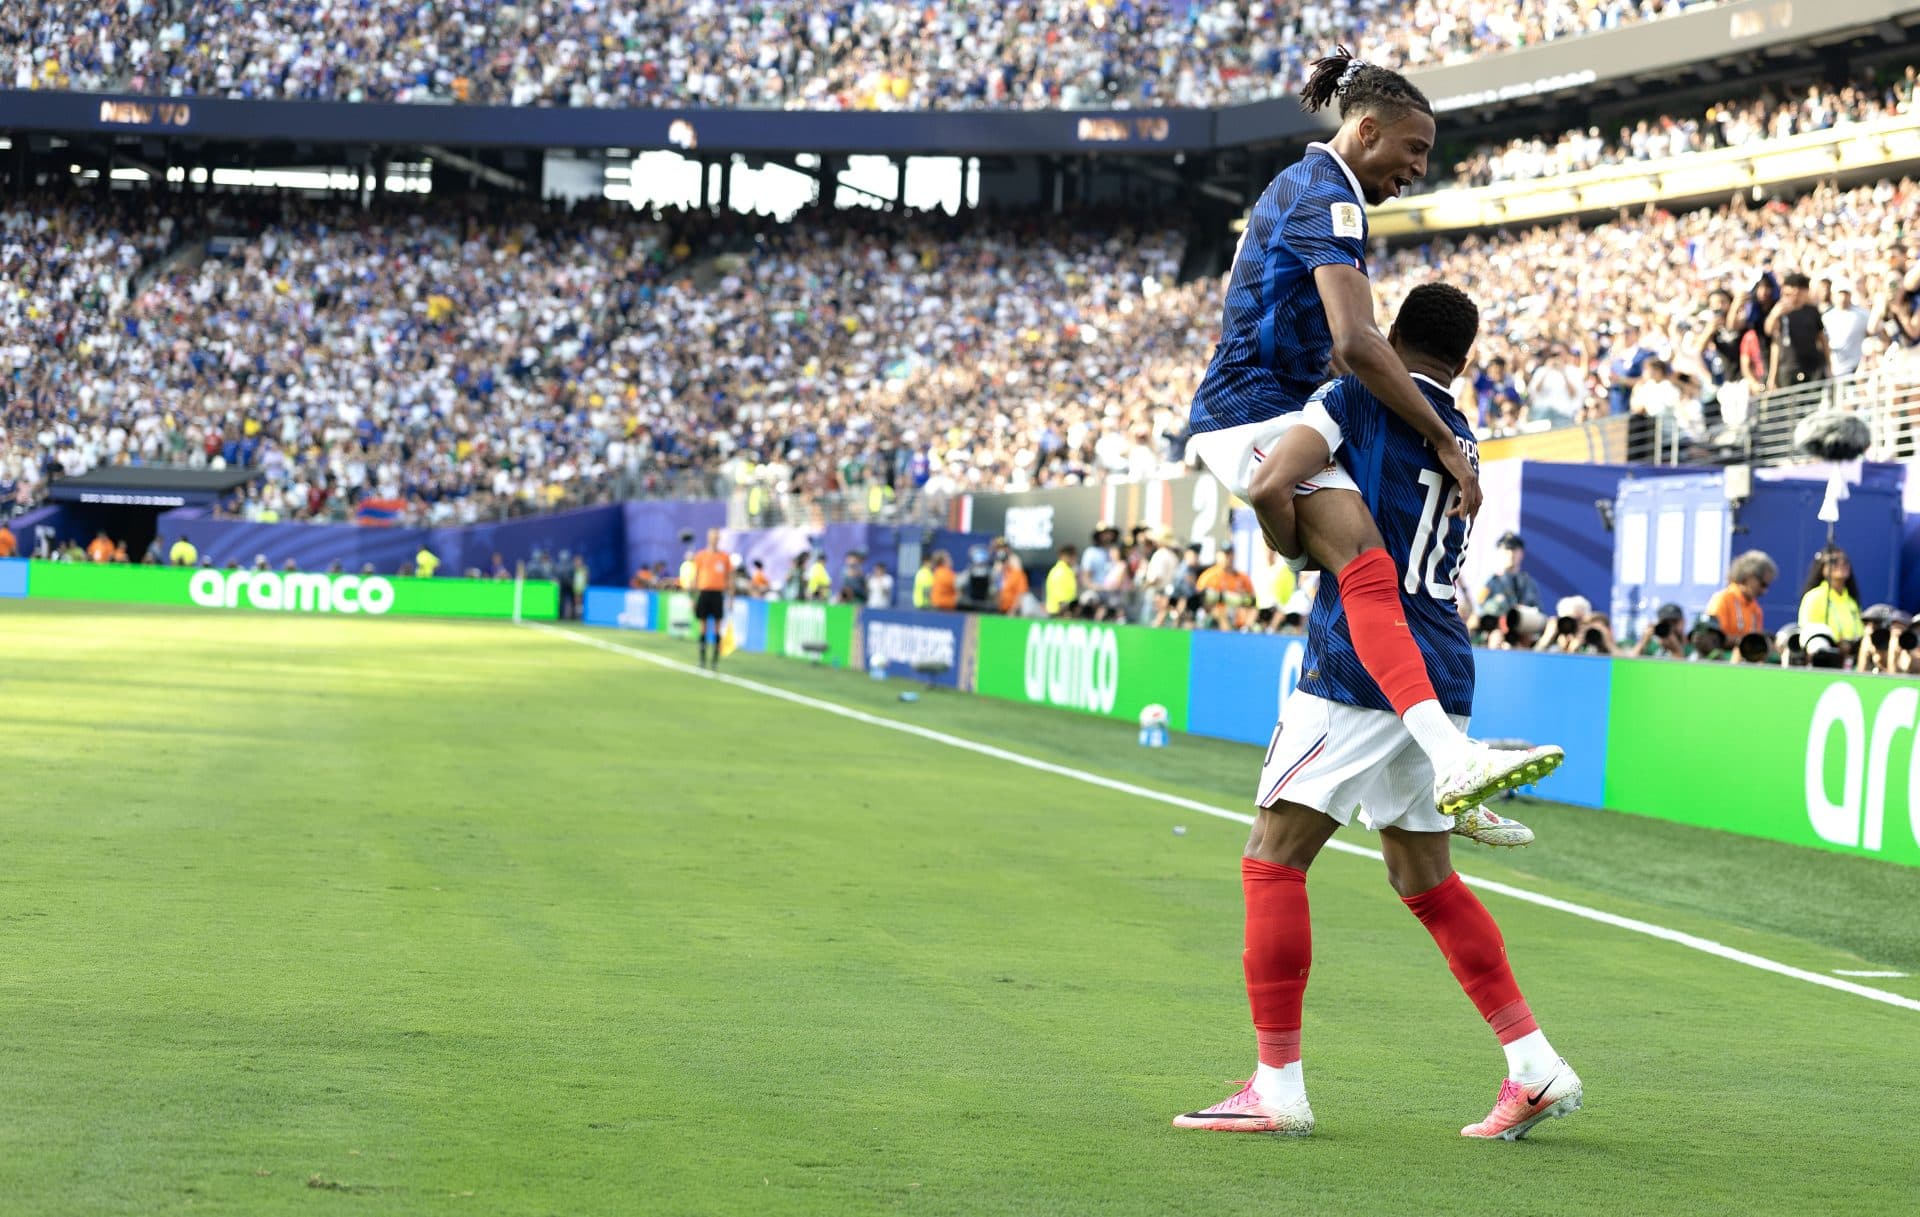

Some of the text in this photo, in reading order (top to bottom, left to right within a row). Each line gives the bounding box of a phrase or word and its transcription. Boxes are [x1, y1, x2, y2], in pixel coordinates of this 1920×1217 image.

[1404, 468, 1471, 599] 10
[189, 568, 394, 614] aramco
[1024, 622, 1118, 714] aramco
